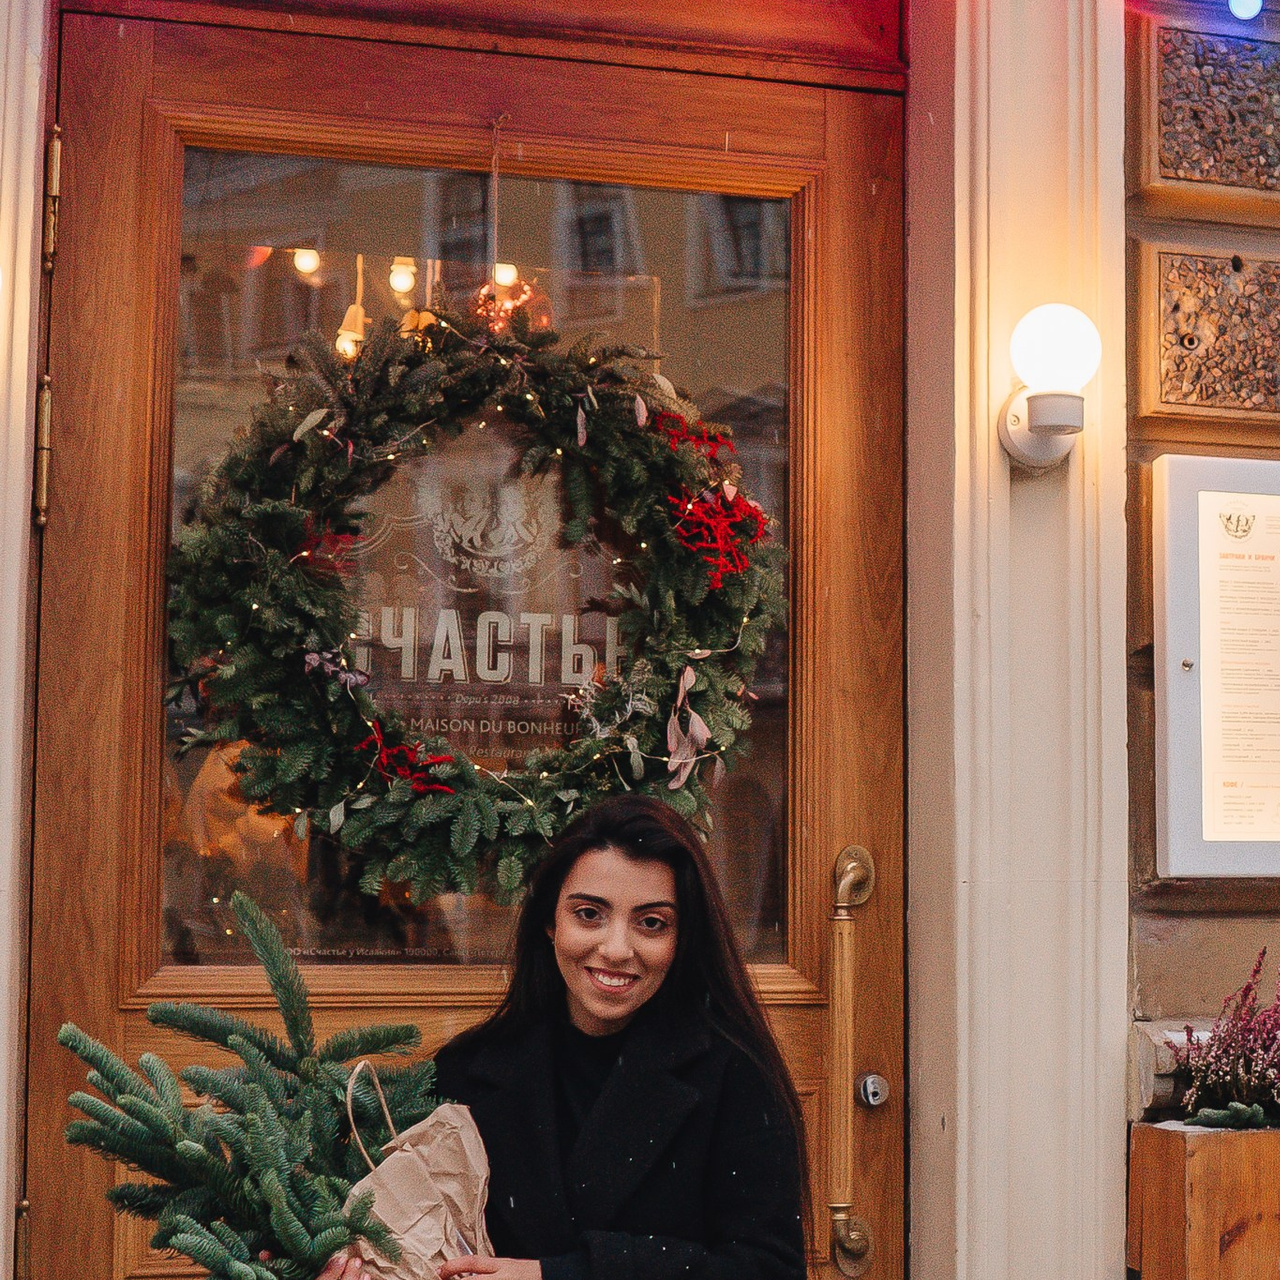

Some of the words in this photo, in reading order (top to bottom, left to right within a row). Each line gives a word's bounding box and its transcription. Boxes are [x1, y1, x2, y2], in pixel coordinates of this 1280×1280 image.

[490, 694, 520, 705] 2008
[410, 718, 475, 734] MAISON
[480, 720, 503, 734] DU
[468, 745, 529, 759] Restaura
